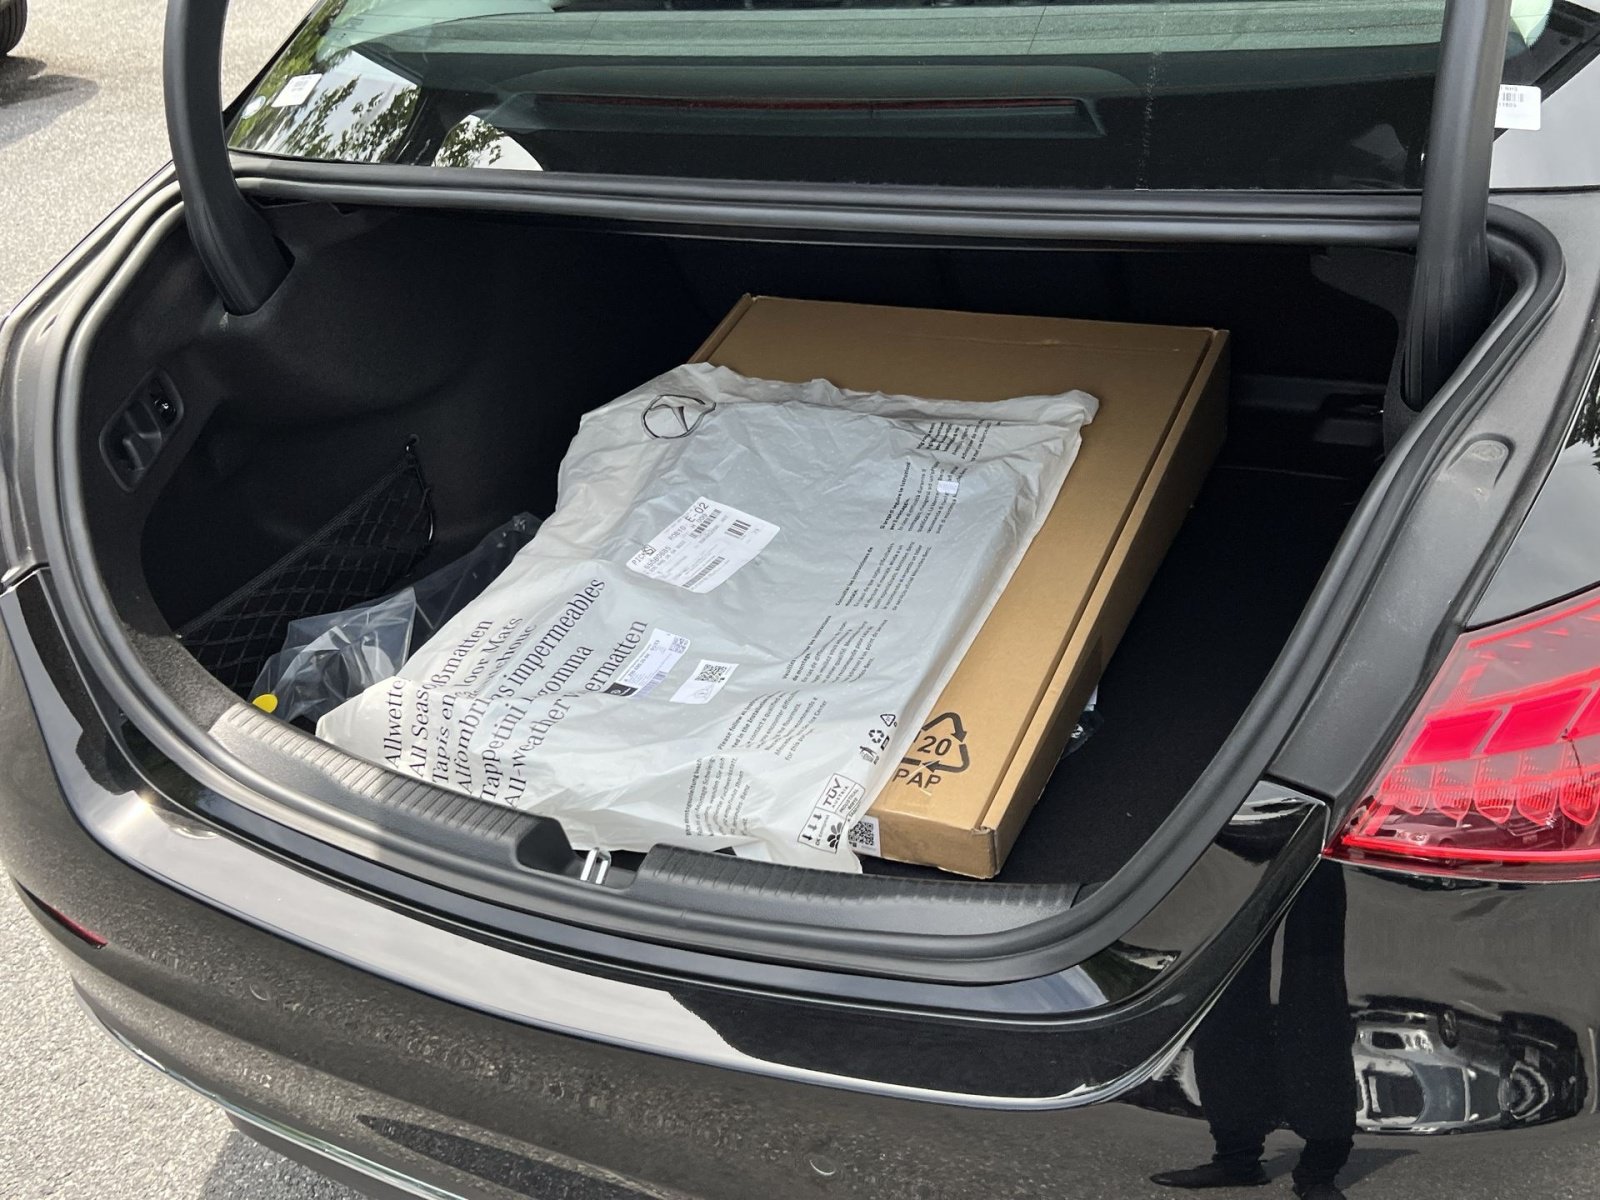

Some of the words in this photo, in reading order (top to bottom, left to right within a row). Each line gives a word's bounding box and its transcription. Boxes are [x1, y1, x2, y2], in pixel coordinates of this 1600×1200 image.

[685, 502, 709, 523] E-02
[481, 618, 524, 653] Mats
[503, 579, 605, 685] impermeables
[454, 658, 489, 687] loor
[384, 680, 405, 769] Allwette
[411, 683, 436, 741] Seaso
[741, 723, 750, 732] the
[432, 726, 450, 784] Tapis
[441, 694, 457, 720] en
[750, 721, 765, 741] contact
[917, 735, 951, 756] 20
[409, 745, 427, 777] All
[480, 702, 528, 799] Tappetini
[504, 698, 571, 809] All-weather
[823, 778, 841, 805] TÜV
[892, 767, 942, 790] PAP
